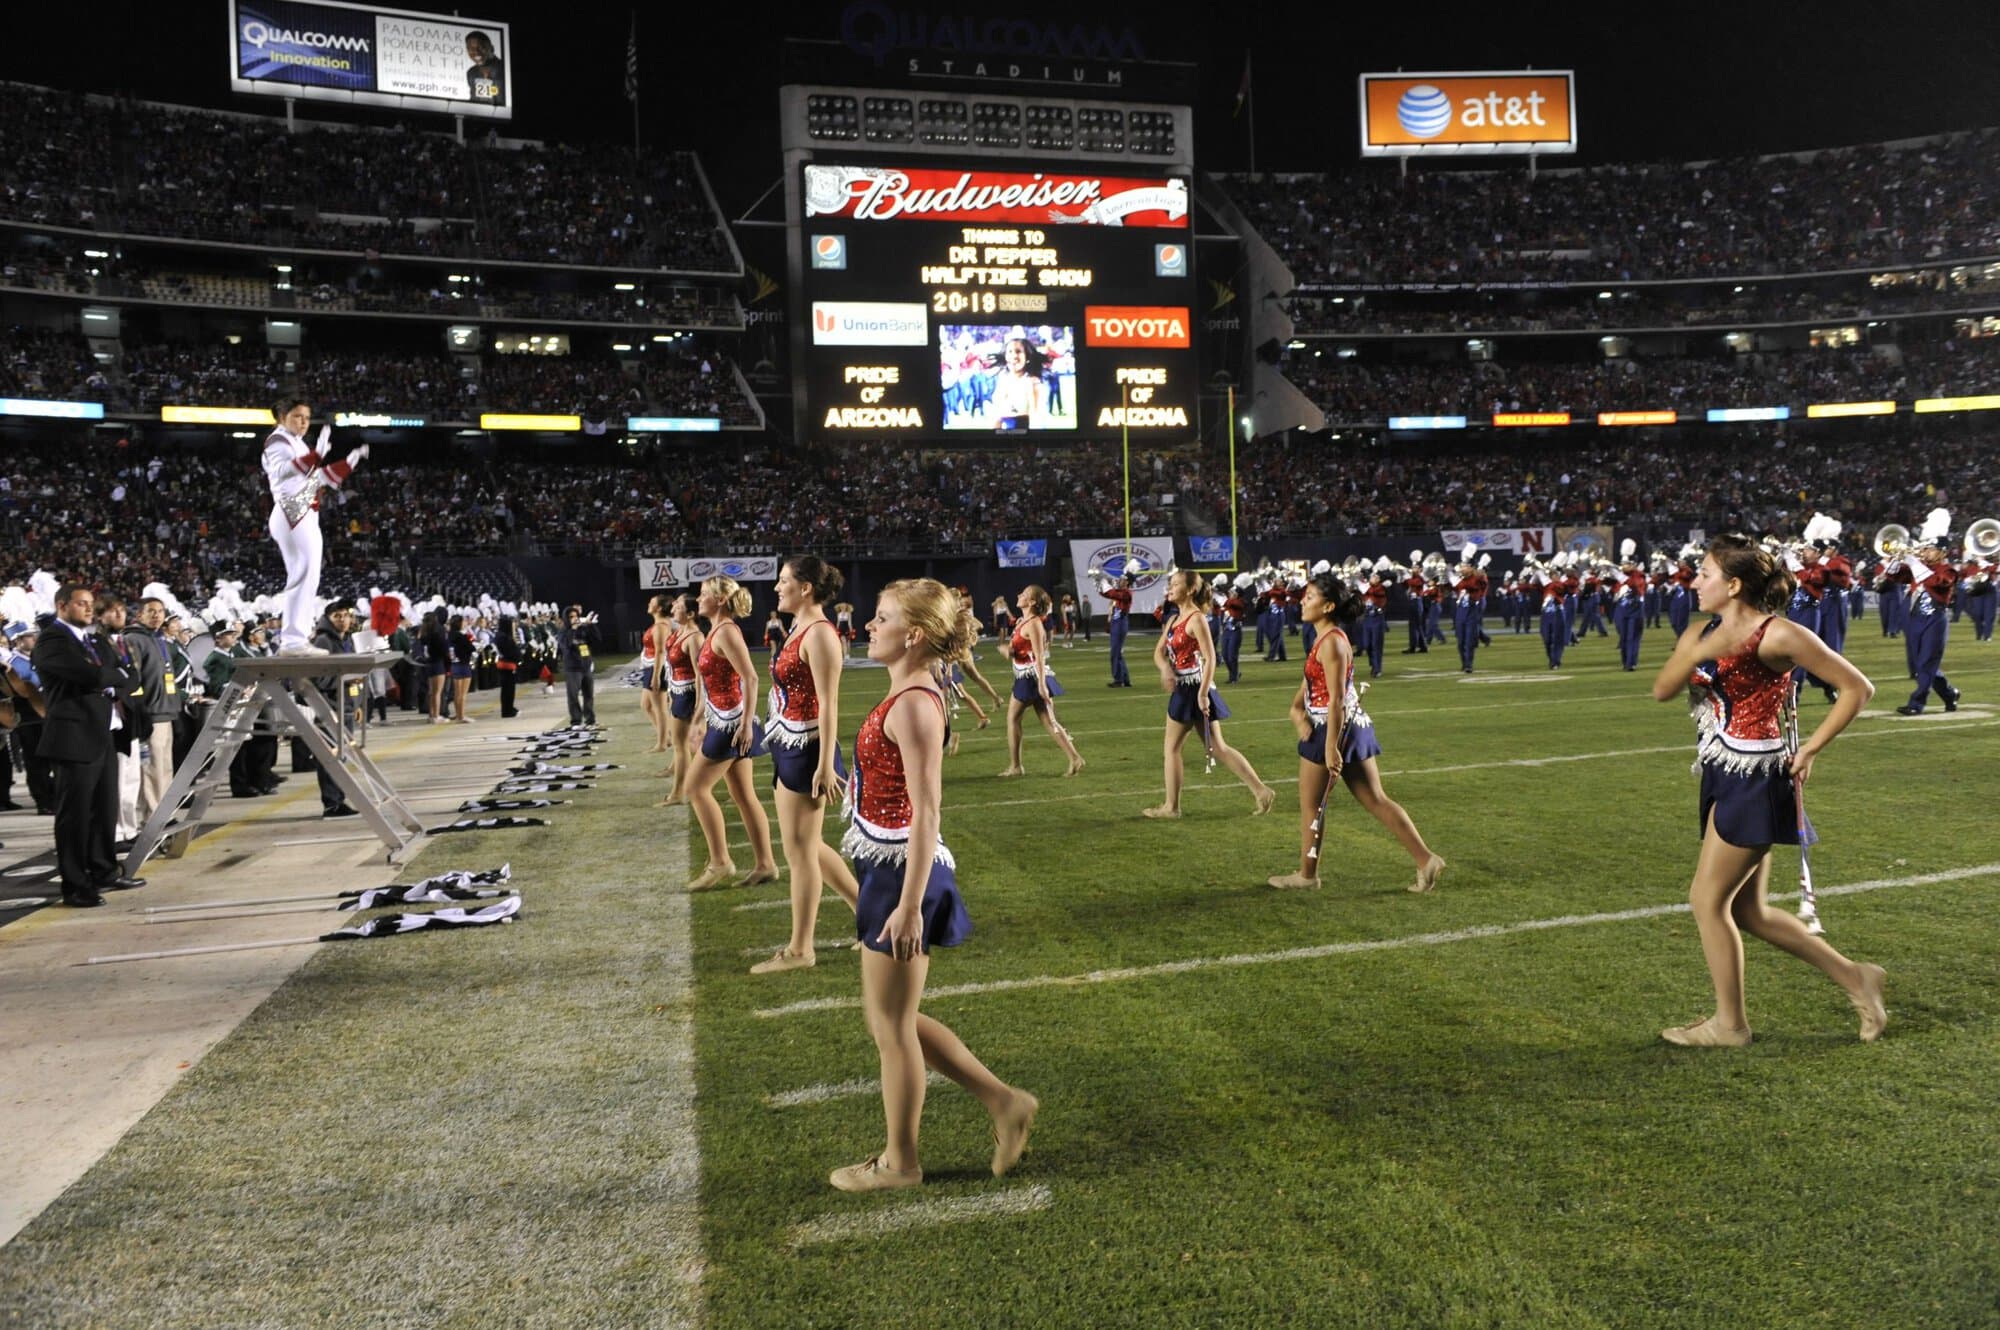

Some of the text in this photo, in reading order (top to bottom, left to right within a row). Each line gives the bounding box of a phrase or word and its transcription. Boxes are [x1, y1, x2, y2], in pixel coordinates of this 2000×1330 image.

[243, 21, 370, 52] QUALCOMM
[382, 22, 463, 42] PALOMAR
[842, 1, 1145, 67] QUALCOMM
[383, 36, 464, 56] POMERADO
[270, 50, 351, 70] Innovation
[383, 51, 465, 70] HEALTH
[909, 59, 1121, 83] STADIUM
[391, 79, 458, 96] www.pph.org
[1461, 91, 1546, 127] at&t
[843, 172, 1101, 219] Budweiser
[962, 229, 1044, 245] THANKS TO
[950, 248, 1057, 265] DR PEPPER
[922, 267, 1091, 286] HALFTIME SHOW
[843, 318, 924, 331] UnionBank
[1090, 318, 1185, 338] TOYOTA
[844, 367, 900, 383] PRIDE
[1117, 368, 1166, 384] PRIDE
[861, 387, 884, 402] OF
[1131, 386, 1153, 402] OF
[824, 407, 923, 427] ARIZONA
[1098, 408, 1188, 426] ARIZONA
[1521, 531, 1543, 552] N
[1097, 546, 1126, 561] PACIFI
[652, 561, 678, 586] A
